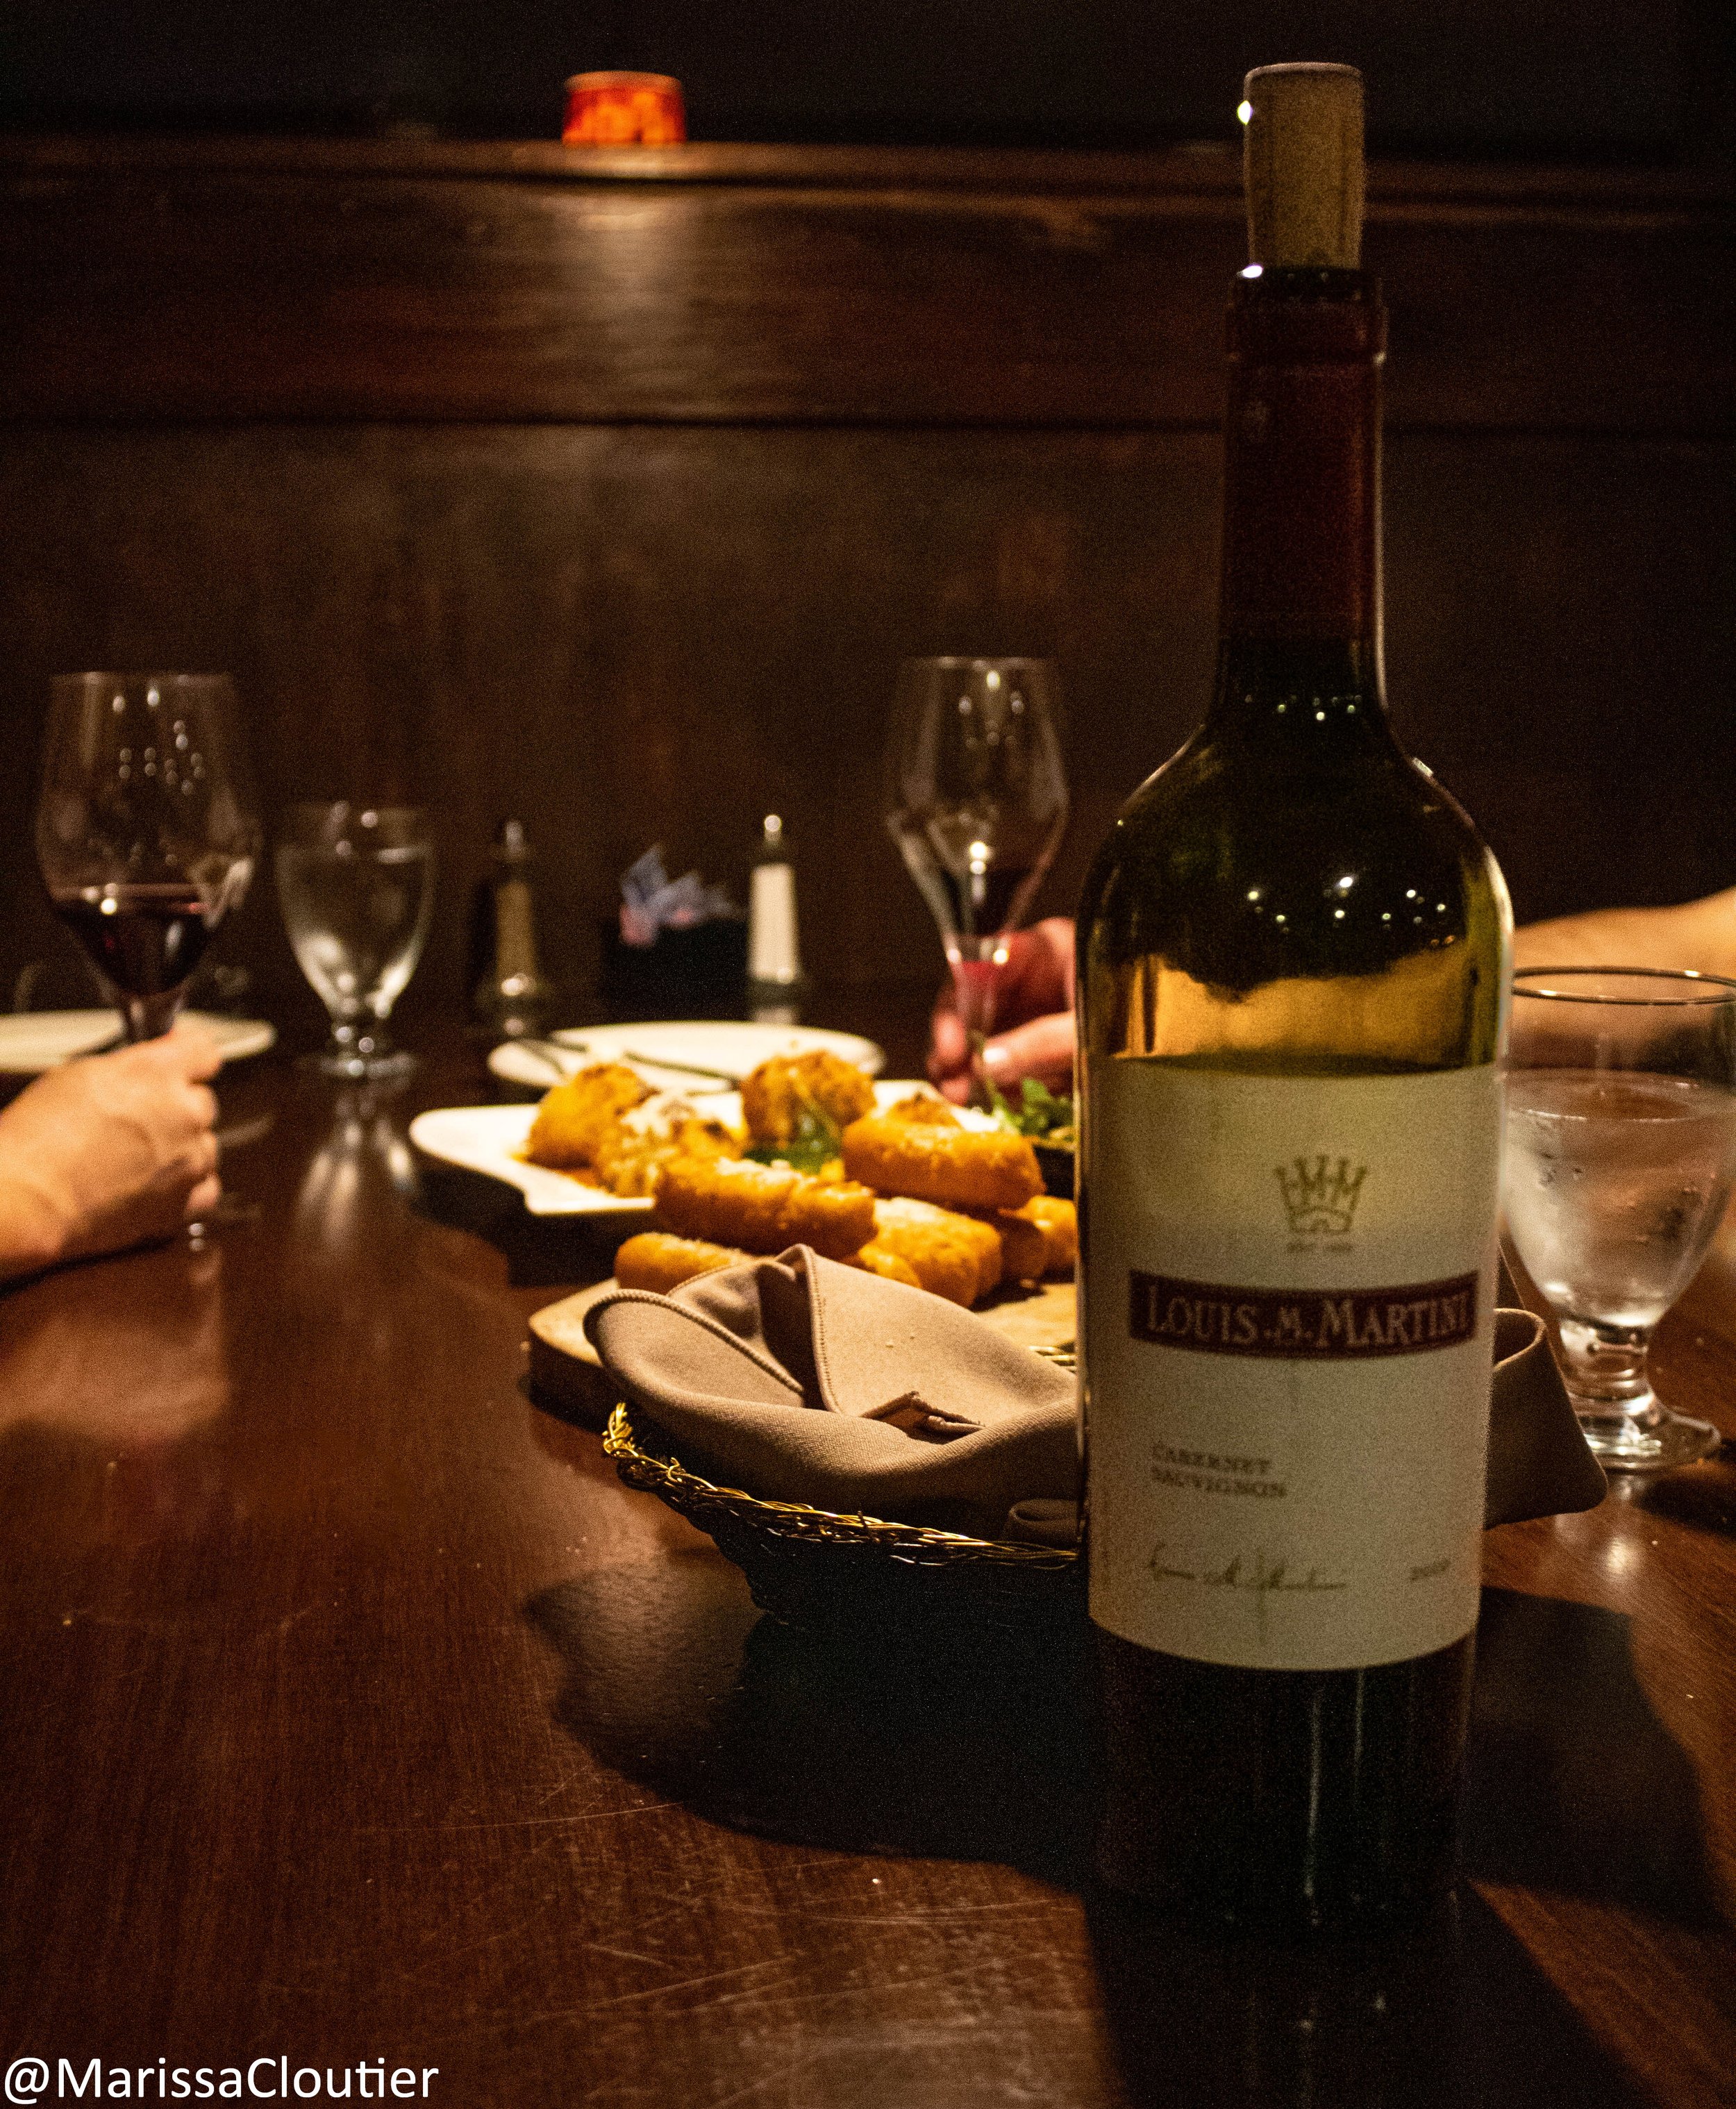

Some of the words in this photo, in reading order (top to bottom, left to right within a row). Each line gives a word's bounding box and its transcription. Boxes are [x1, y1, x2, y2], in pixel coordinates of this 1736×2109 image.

[1146, 1283, 1258, 1345] LOUIS
[1315, 1290, 1469, 1348] MARTINI
[1151, 1442, 1271, 1476] CABERNET
[1150, 1465, 1287, 1499] SAUVIGNON
